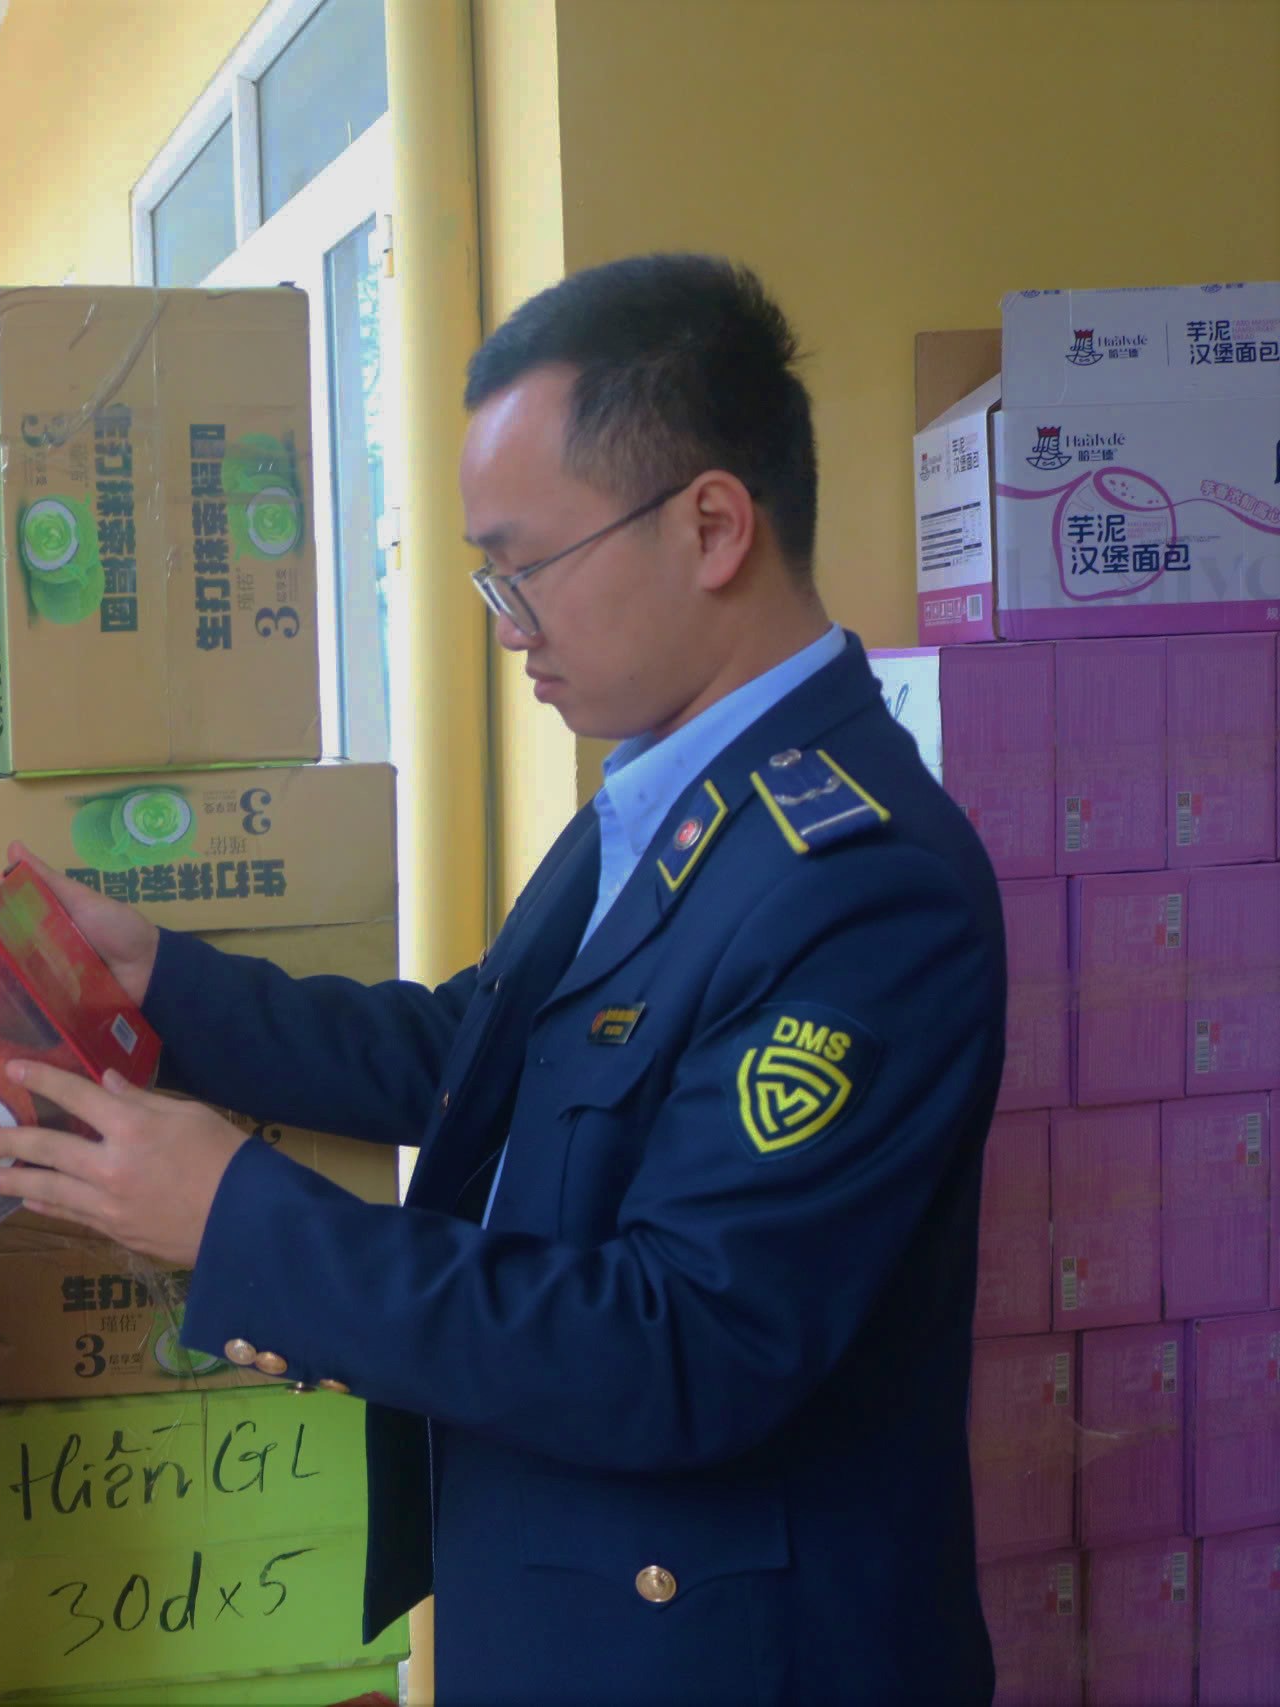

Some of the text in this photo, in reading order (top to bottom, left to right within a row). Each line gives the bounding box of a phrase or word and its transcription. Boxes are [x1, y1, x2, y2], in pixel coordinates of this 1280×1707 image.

[1186, 320, 1231, 341] 芋泥
[1190, 341, 1280, 365] 汉堡面包
[1068, 514, 1126, 543] 芋泥
[1072, 544, 1191, 575] 汉堡面包
[255, 607, 299, 639] 3
[240, 788, 272, 835] 3
[773, 1015, 852, 1062] DMS
[74, 1334, 106, 1377] 3
